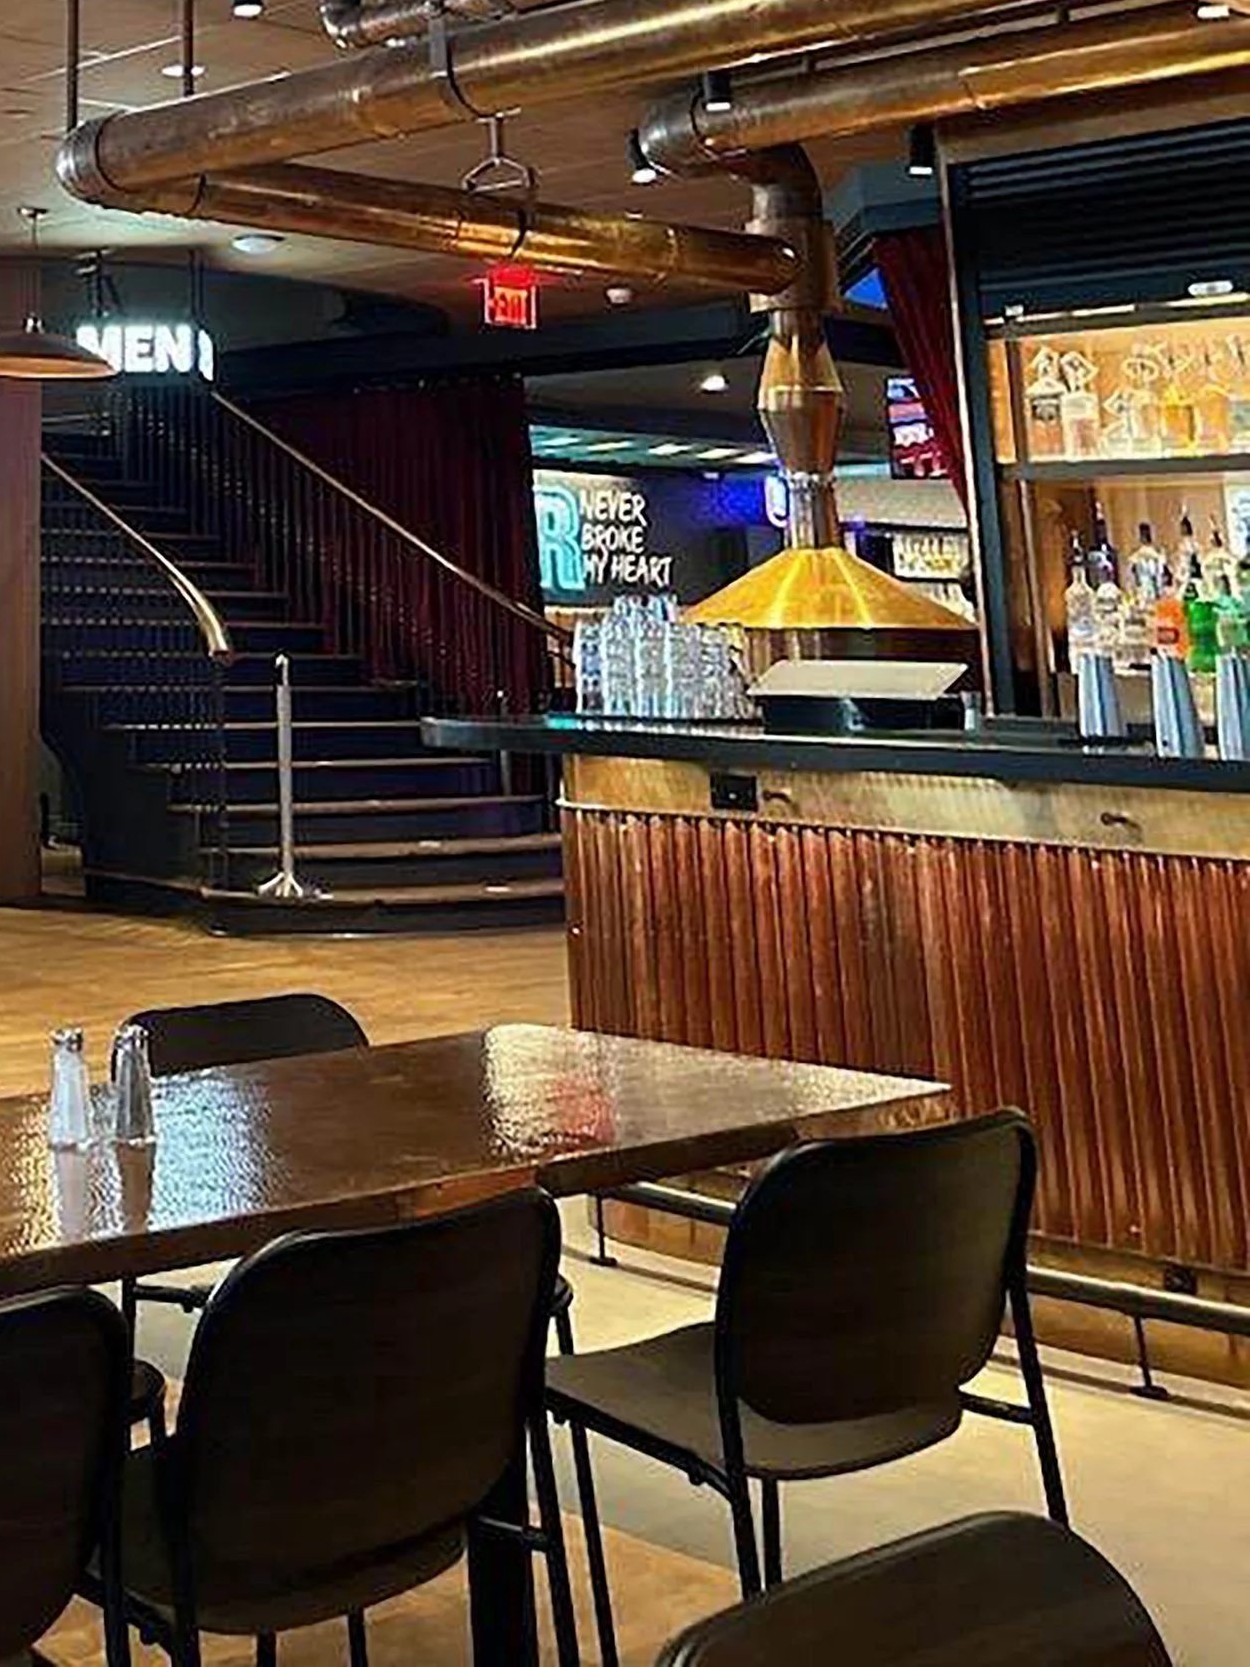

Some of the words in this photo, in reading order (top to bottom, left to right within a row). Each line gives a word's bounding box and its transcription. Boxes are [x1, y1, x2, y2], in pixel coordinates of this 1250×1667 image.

[579, 489, 648, 527] NEVER
[580, 522, 645, 554] BROKE
[581, 553, 609, 584] MY
[610, 553, 673, 588] HEART
